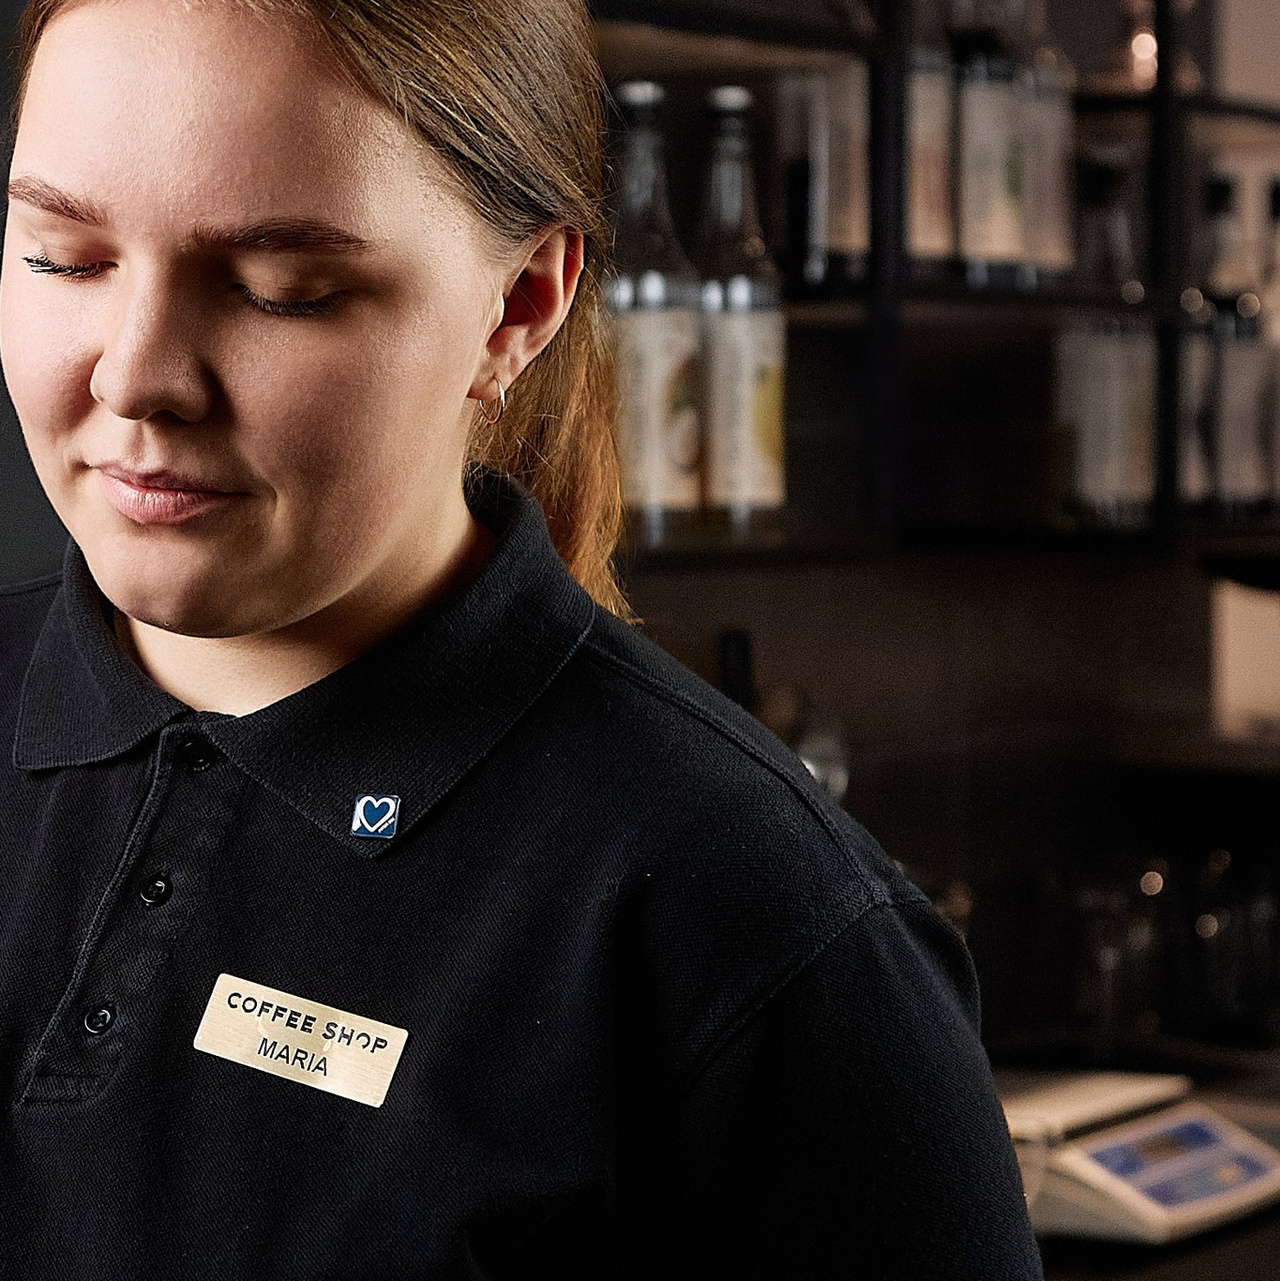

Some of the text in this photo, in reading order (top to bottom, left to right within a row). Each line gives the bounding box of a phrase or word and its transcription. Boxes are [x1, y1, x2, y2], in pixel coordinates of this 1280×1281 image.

[227, 992, 388, 1054] COFFEE SHOP
[257, 1037, 328, 1076] MARIA
